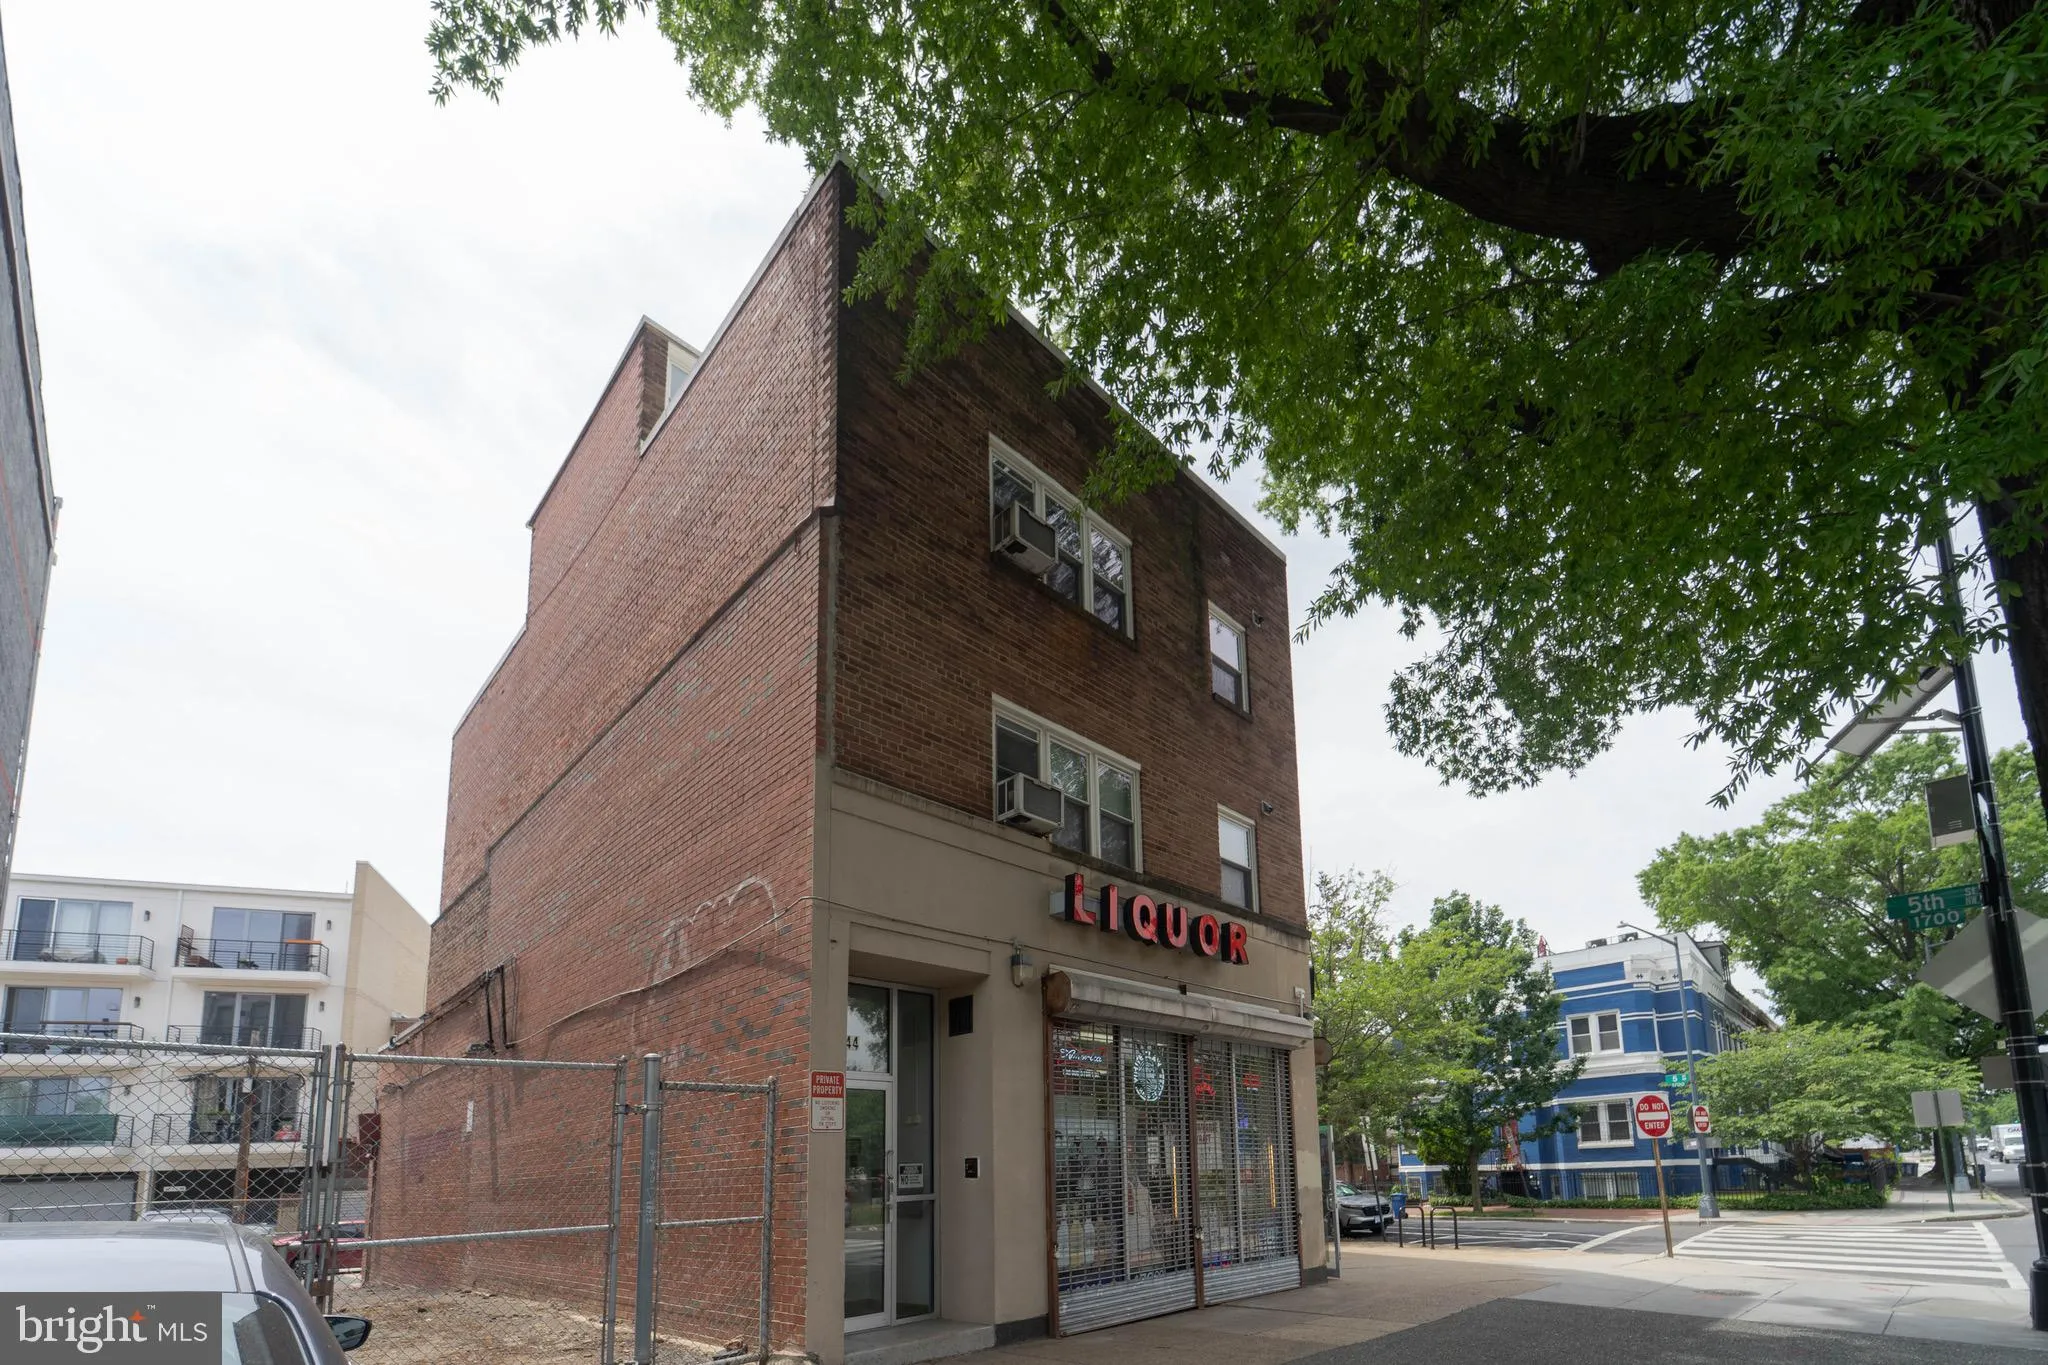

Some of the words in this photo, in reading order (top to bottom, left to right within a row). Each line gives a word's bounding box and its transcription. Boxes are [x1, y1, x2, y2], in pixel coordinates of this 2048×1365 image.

[1907, 893, 1945, 914] 5th
[1065, 872, 1249, 965] LIQUOR
[1914, 910, 1960, 928] 1700
[815, 1074, 841, 1085] PRIVATE
[812, 1085, 843, 1095] PROPERTY
[1640, 1103, 1649, 1111] DO
[1652, 1102, 1664, 1110] NOT
[1644, 1121, 1665, 1130] ENTER
